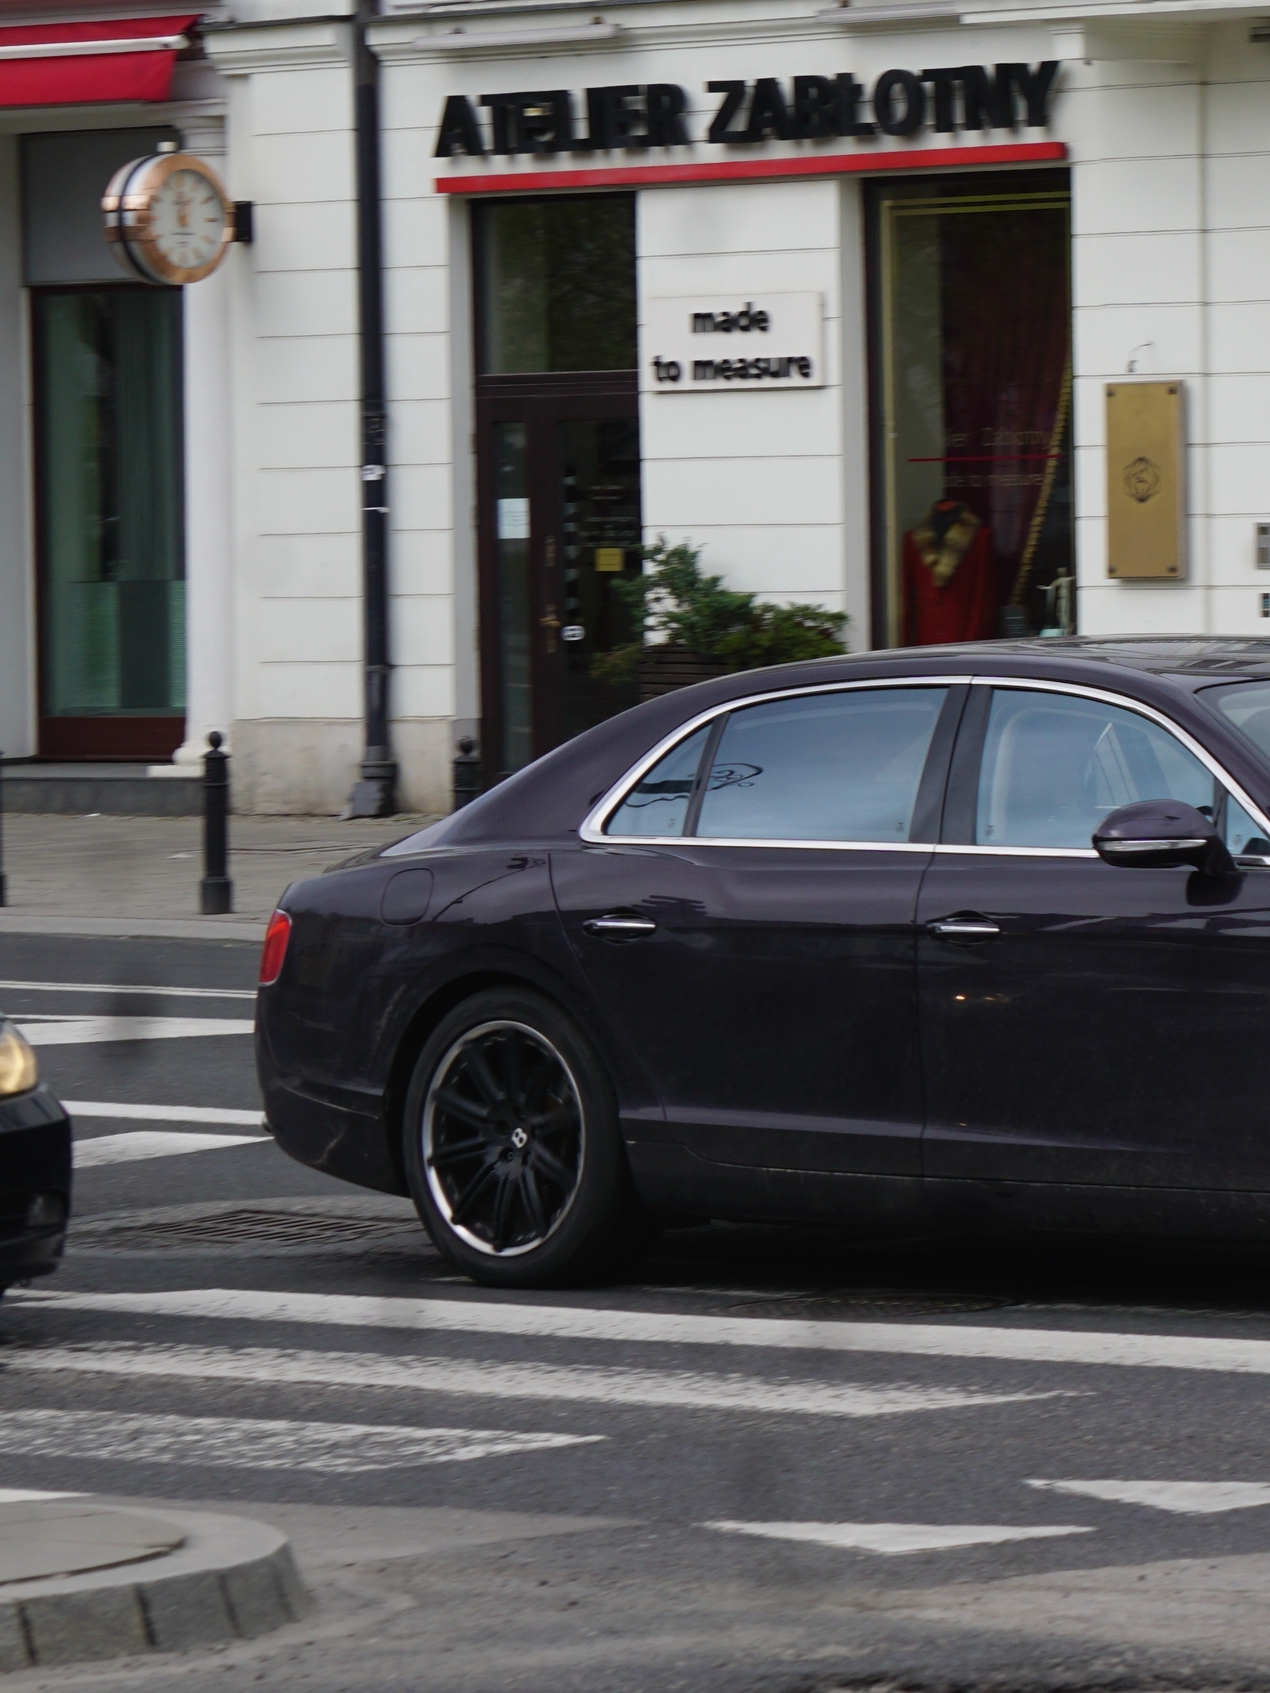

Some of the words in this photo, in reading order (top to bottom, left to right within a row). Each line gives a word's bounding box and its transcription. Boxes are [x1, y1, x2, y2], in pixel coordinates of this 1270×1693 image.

[434, 83, 692, 157] ATELIER
[705, 61, 1061, 143] ZABŁOTNY
[691, 301, 770, 333] made
[651, 355, 681, 382] to
[692, 356, 812, 380] measure
